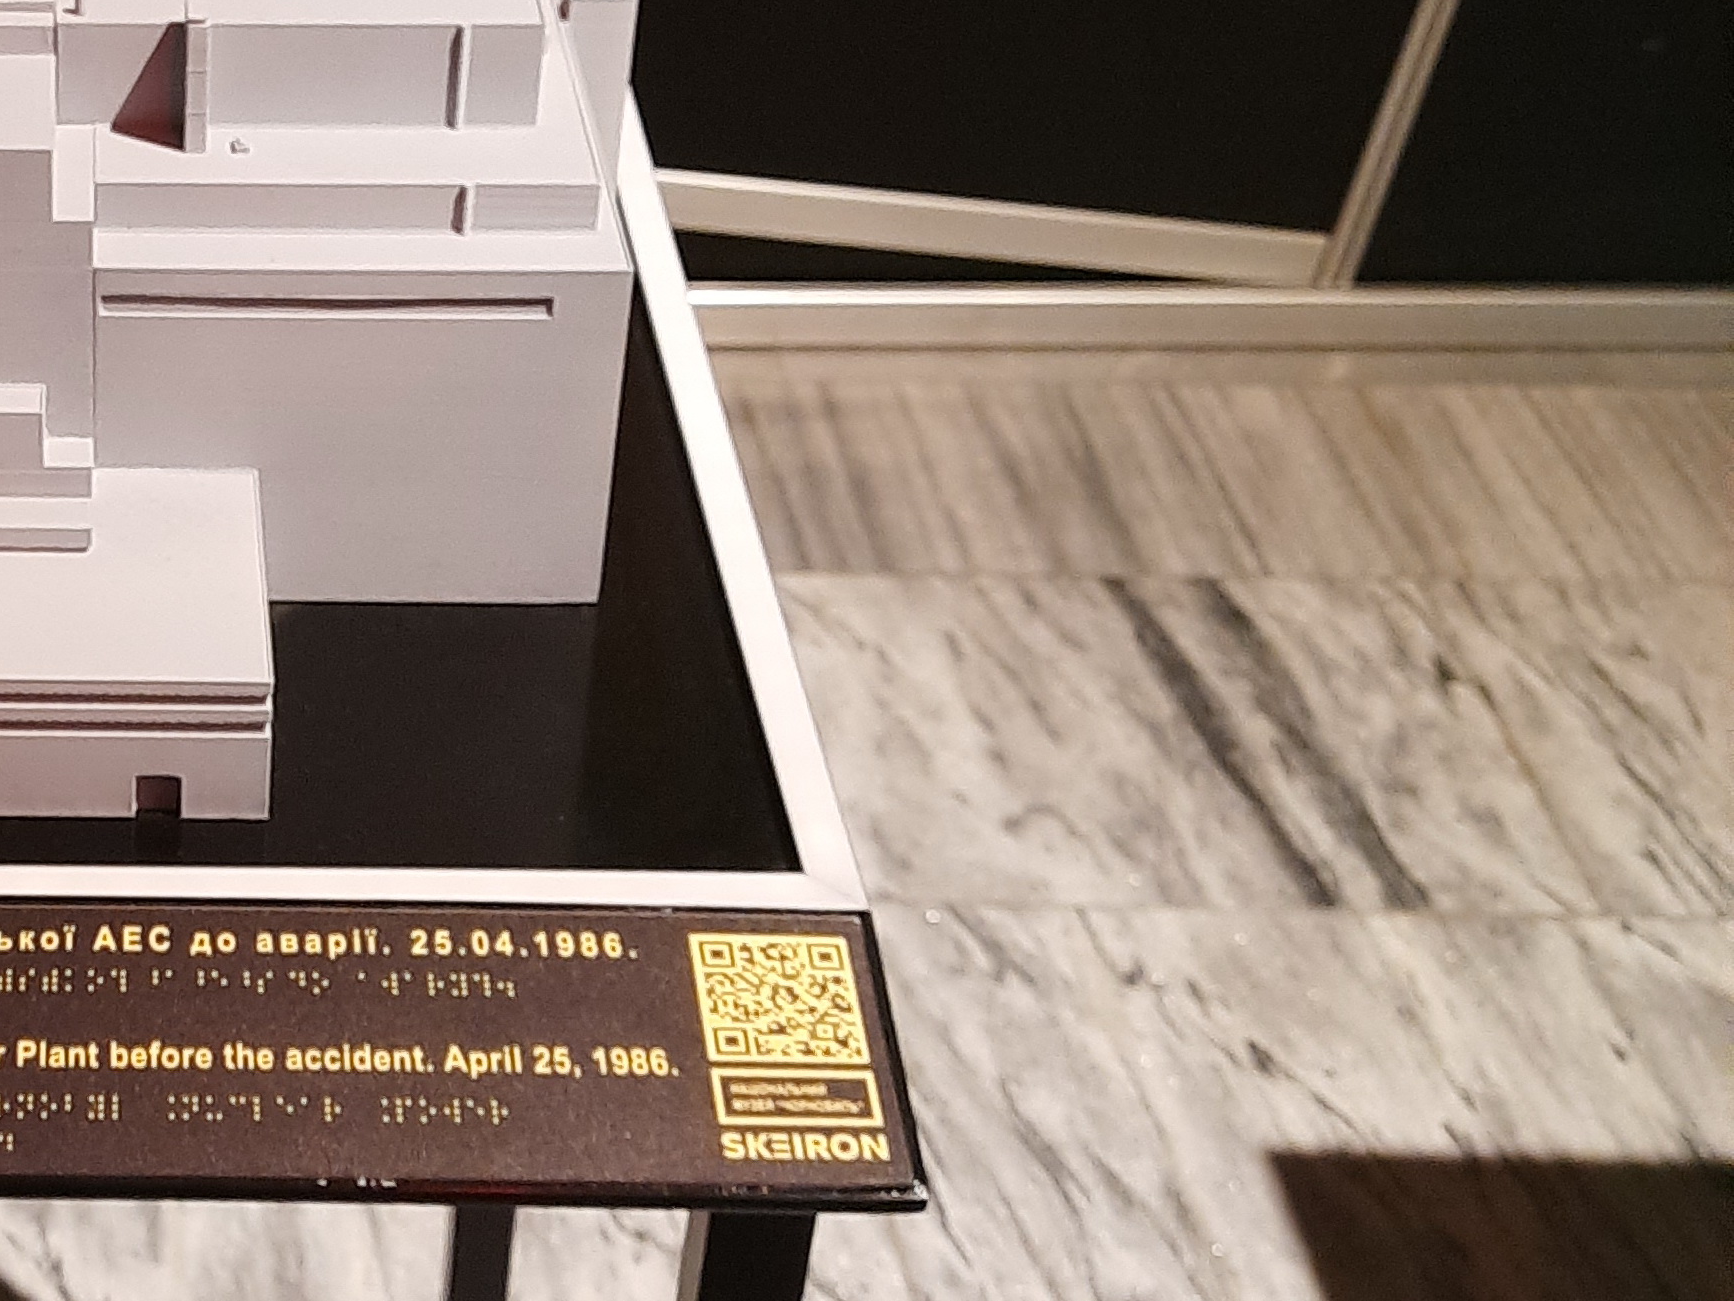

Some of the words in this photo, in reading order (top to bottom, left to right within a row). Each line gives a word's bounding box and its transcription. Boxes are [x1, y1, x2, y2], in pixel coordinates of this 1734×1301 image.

[91, 924, 171, 953] АЕС
[188, 930, 237, 957] до
[255, 926, 391, 960] аварії.
[409, 928, 639, 960] 25.04.1986.
[15, 1038, 100, 1070] Plant
[107, 1039, 214, 1071] before
[221, 1040, 276, 1073] the
[284, 1042, 435, 1074] accident.
[443, 1042, 523, 1080] April
[532, 1044, 583, 1079] 25,
[590, 1046, 680, 1077] 1986.
[720, 1130, 891, 1162] SKEIRON
